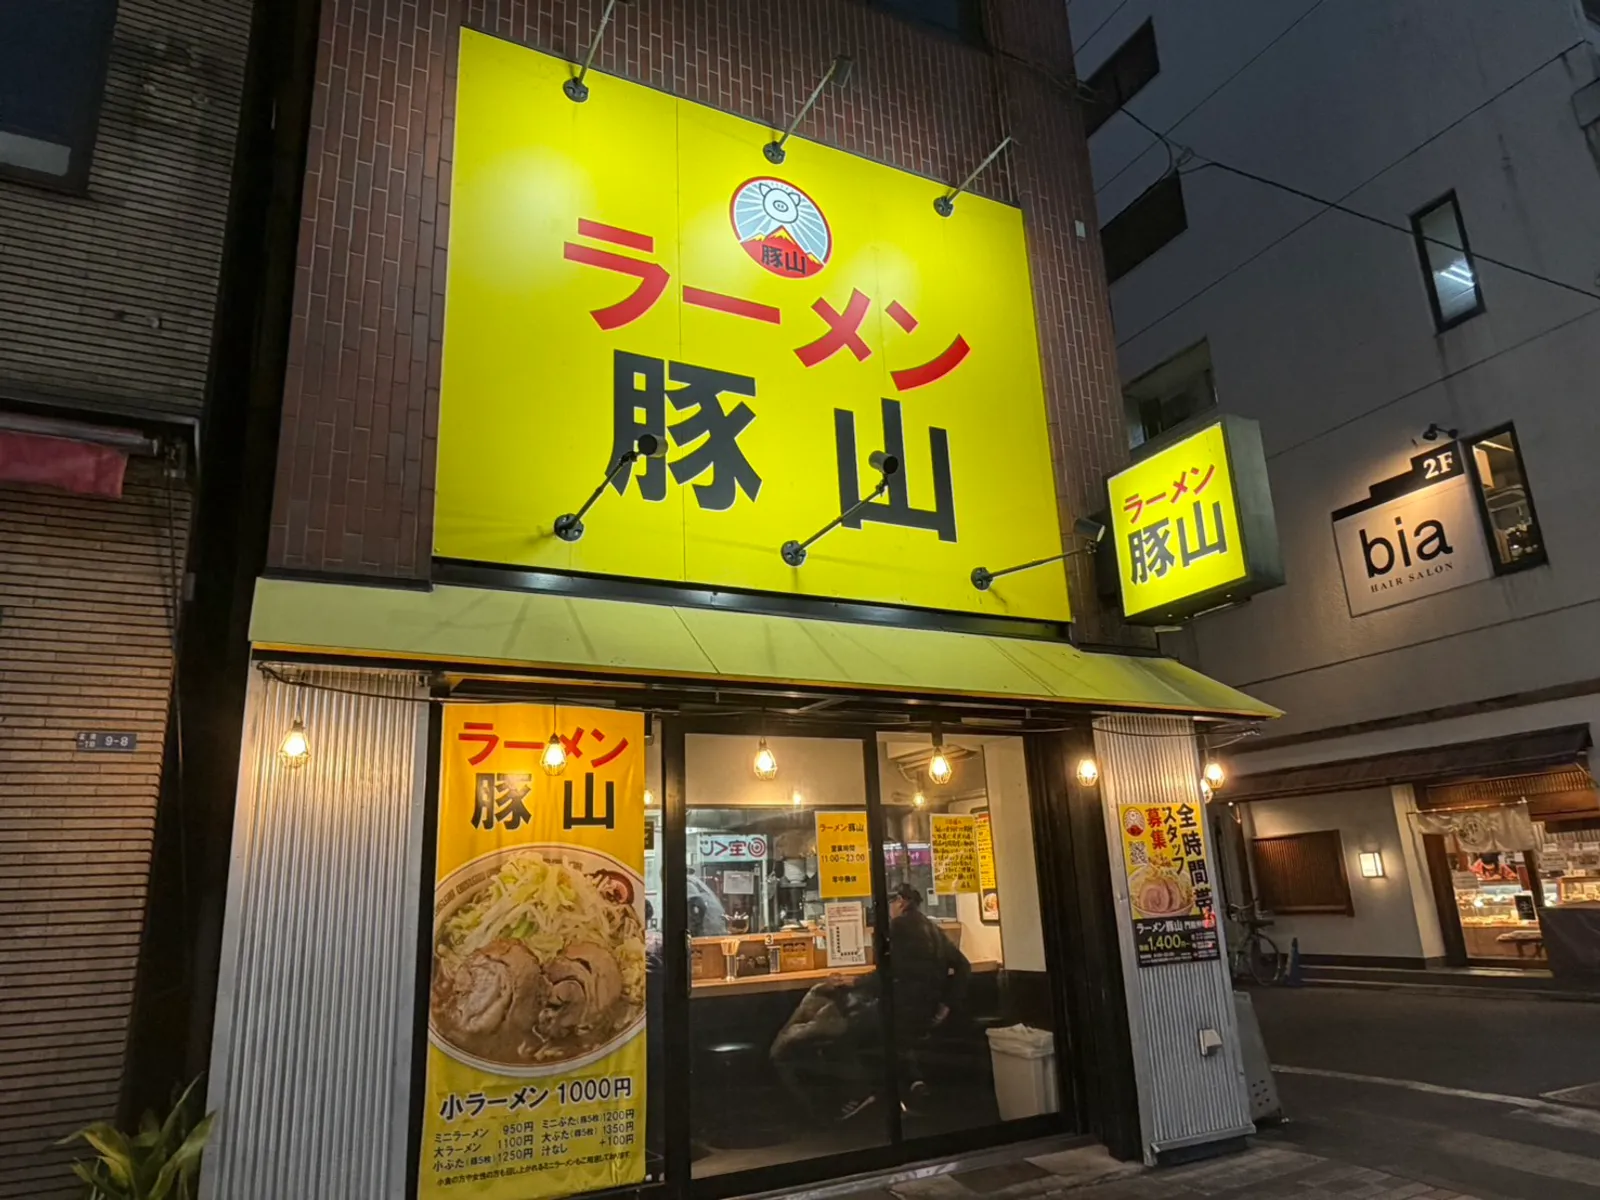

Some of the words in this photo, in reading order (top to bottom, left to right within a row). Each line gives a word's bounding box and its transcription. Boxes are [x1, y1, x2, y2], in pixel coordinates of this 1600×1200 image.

[762, 244, 807, 275] 豚山
[563, 217, 971, 391] ラーメン
[604, 349, 958, 543] 豚山
[1422, 451, 1453, 480] 2F
[1123, 464, 1215, 524] ラーメン
[1128, 500, 1228, 586] 豚山
[1358, 516, 1454, 578] bia
[1370, 577, 1404, 593] HAIR
[1408, 562, 1454, 582] SALON
[105, 735, 129, 747] 9-8
[458, 721, 629, 768] ラーメン
[471, 772, 615, 830] 豚山
[1146, 807, 1167, 850] 募集
[1161, 806, 1185, 875] スタッフ
[1176, 803, 1213, 914] 全時間帯
[765, 934, 773, 943] 3
[438, 1085, 549, 1120] 小ラーメン
[557, 1077, 632, 1104] 1000円
[602, 1108, 635, 1120] 1200円
[433, 1142, 482, 1158] 大ラーメン
[498, 1134, 534, 1149] 1100円
[434, 1128, 489, 1143] ミニラーメン
[502, 1121, 534, 1135] 950円
[541, 1143, 568, 1157] 汁なし
[599, 1134, 635, 1147] +100円
[602, 1121, 635, 1135] 1350円
[497, 1147, 534, 1162] 1250円
